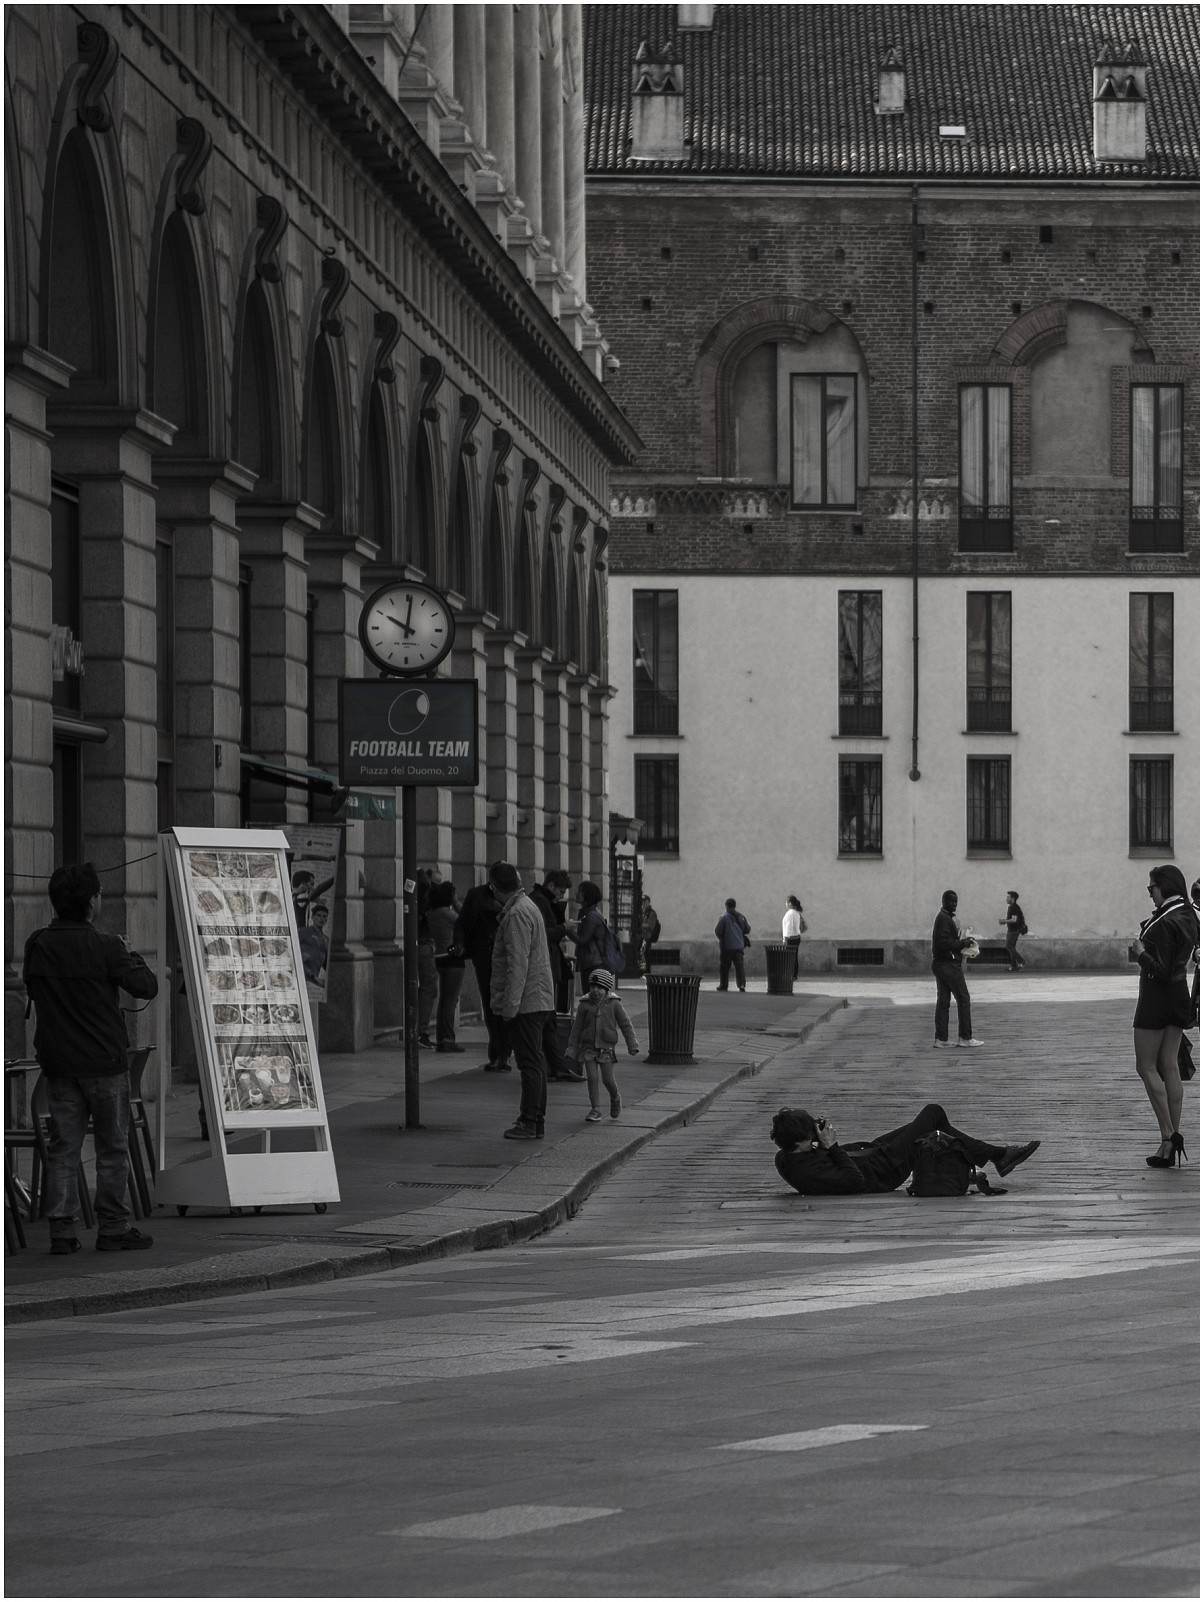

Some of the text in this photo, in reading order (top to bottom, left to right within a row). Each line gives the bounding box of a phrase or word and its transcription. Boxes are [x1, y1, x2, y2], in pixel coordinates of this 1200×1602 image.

[350, 741, 469, 758] FOOTBALL TEAM
[360, 766, 459, 776] Piazza del Duomo, 20
[202, 926, 242, 936] RESTAURANT
[266, 926, 286, 936] PIZZA
